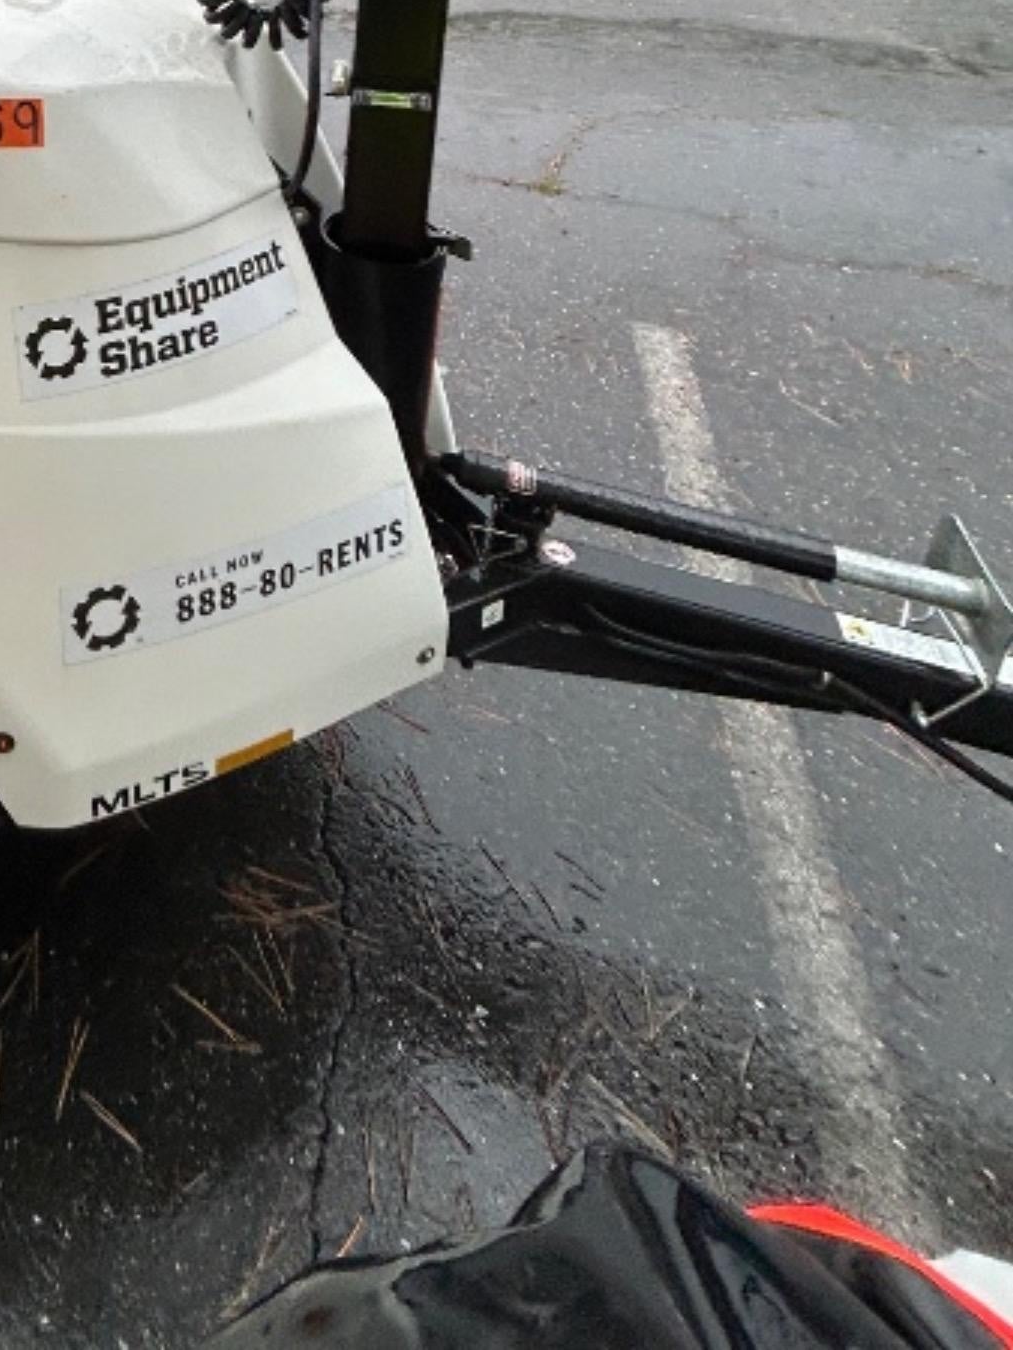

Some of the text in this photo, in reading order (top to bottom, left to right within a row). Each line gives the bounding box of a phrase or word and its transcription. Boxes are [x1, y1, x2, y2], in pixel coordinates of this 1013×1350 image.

[94, 239, 286, 334] Equipment
[99, 319, 220, 378] Share
[175, 549, 264, 589] CALL NOW
[175, 518, 404, 624] 888-80-RENTS
